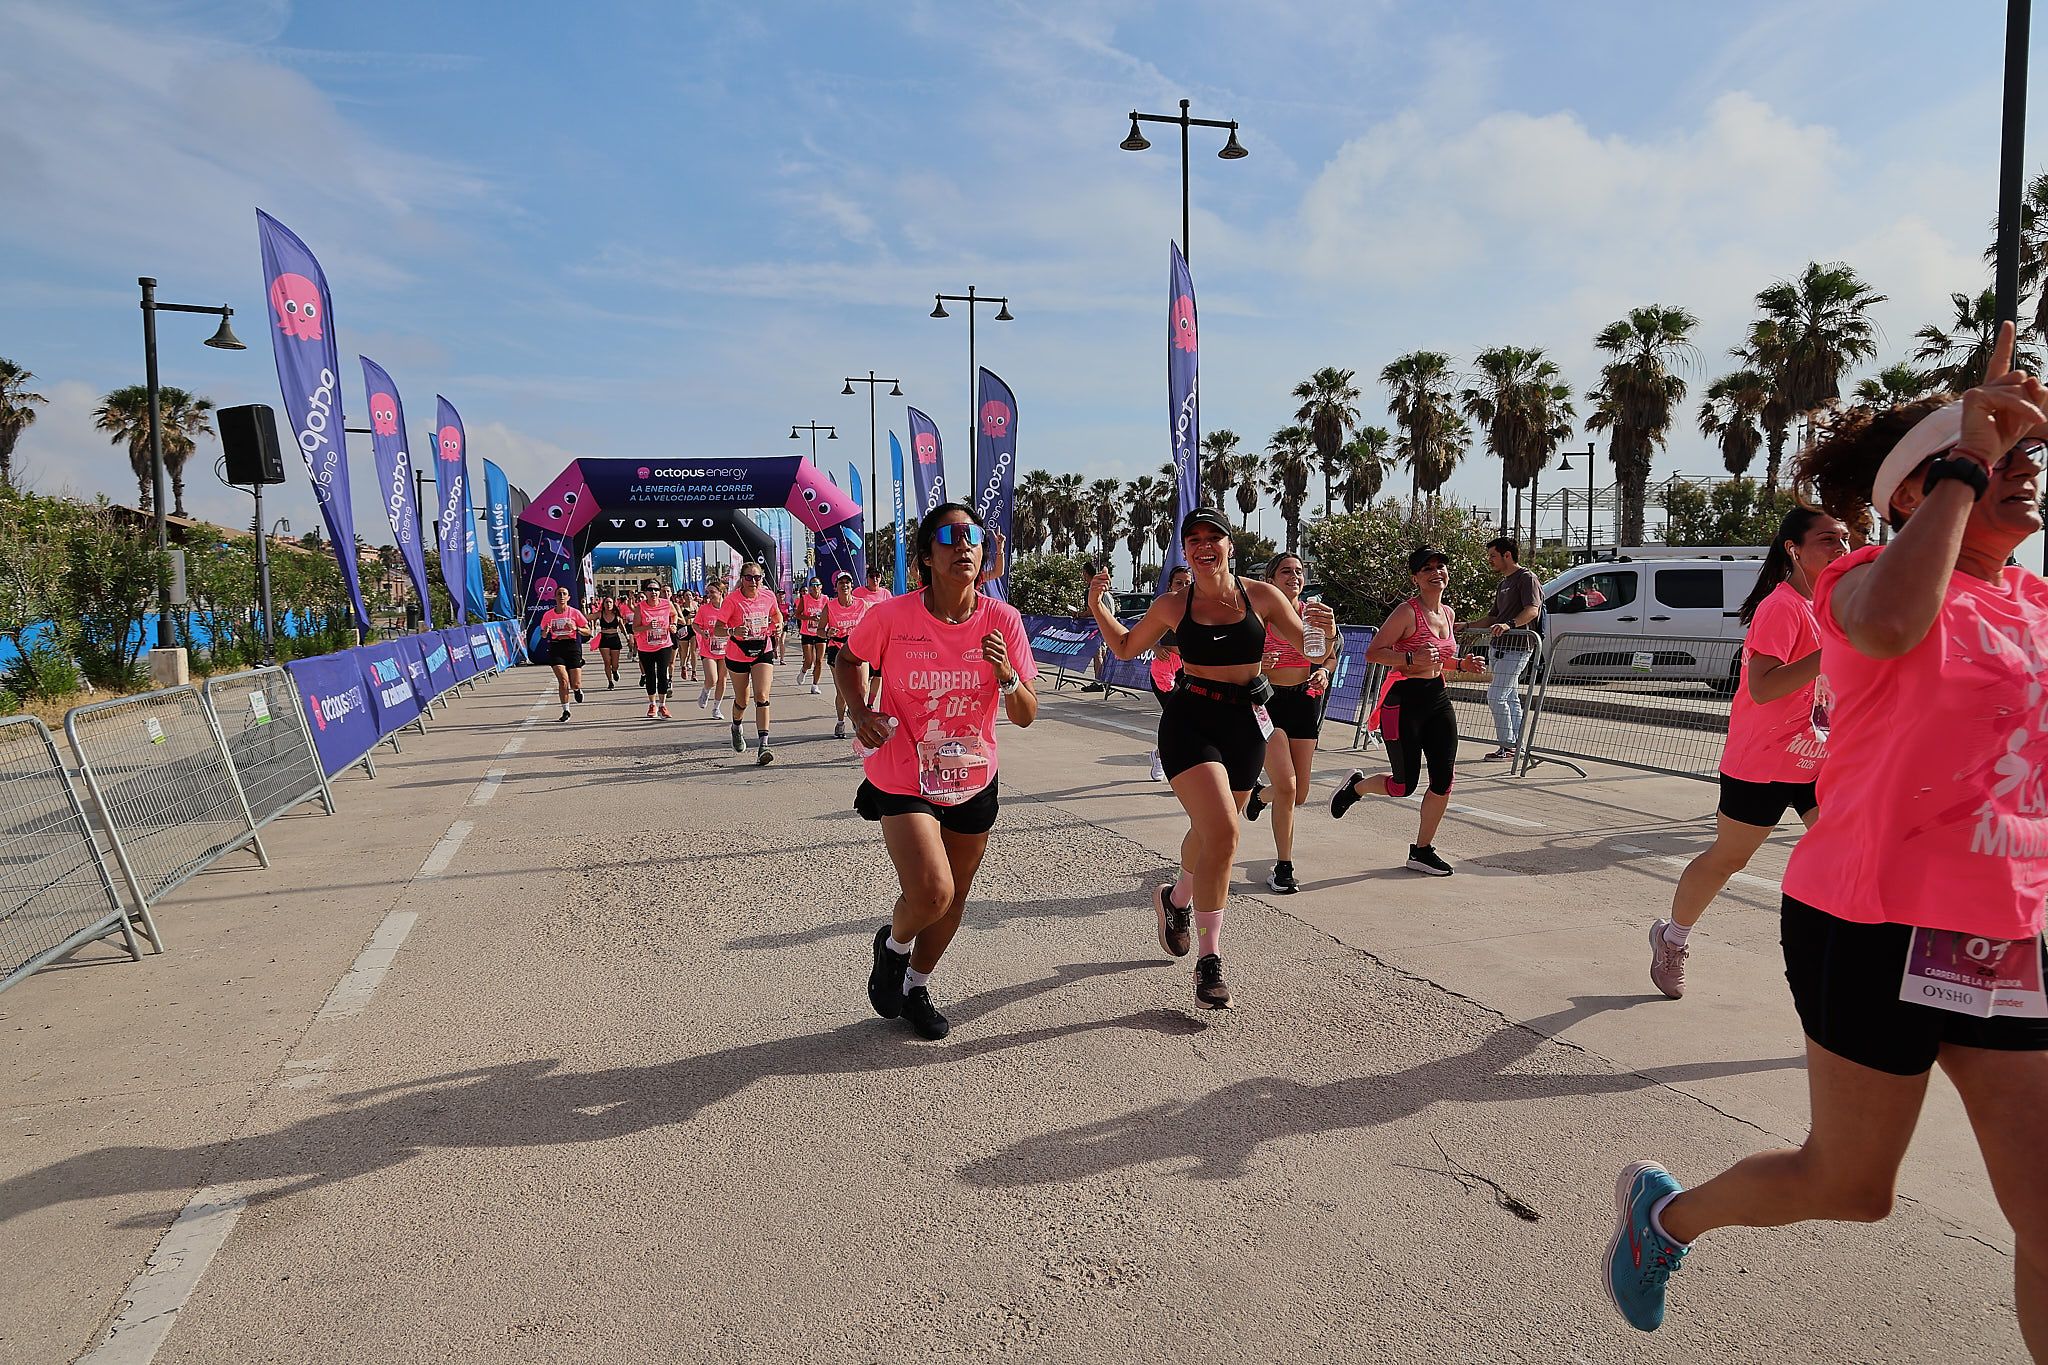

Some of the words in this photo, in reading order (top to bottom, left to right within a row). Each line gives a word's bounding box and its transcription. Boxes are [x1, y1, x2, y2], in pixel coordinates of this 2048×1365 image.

[655, 468, 705, 480] octopus
[706, 469, 748, 480] energy
[630, 485, 643, 493] LA
[645, 484, 686, 493] ENERGÍA
[688, 485, 713, 493] PARA
[716, 484, 753, 492] CORRER
[609, 518, 714, 529] VOLVO
[905, 651, 938, 660] OYSHO
[908, 670, 982, 690] CARRERA
[945, 696, 972, 718] DE
[1795, 758, 1816, 769] 2026
[941, 767, 969, 781] 016
[1924, 967, 1961, 981] CARRERA
[1961, 974, 1971, 984] DE
[1971, 977, 1983, 987] LA
[1922, 984, 1973, 1005] OYSHO
